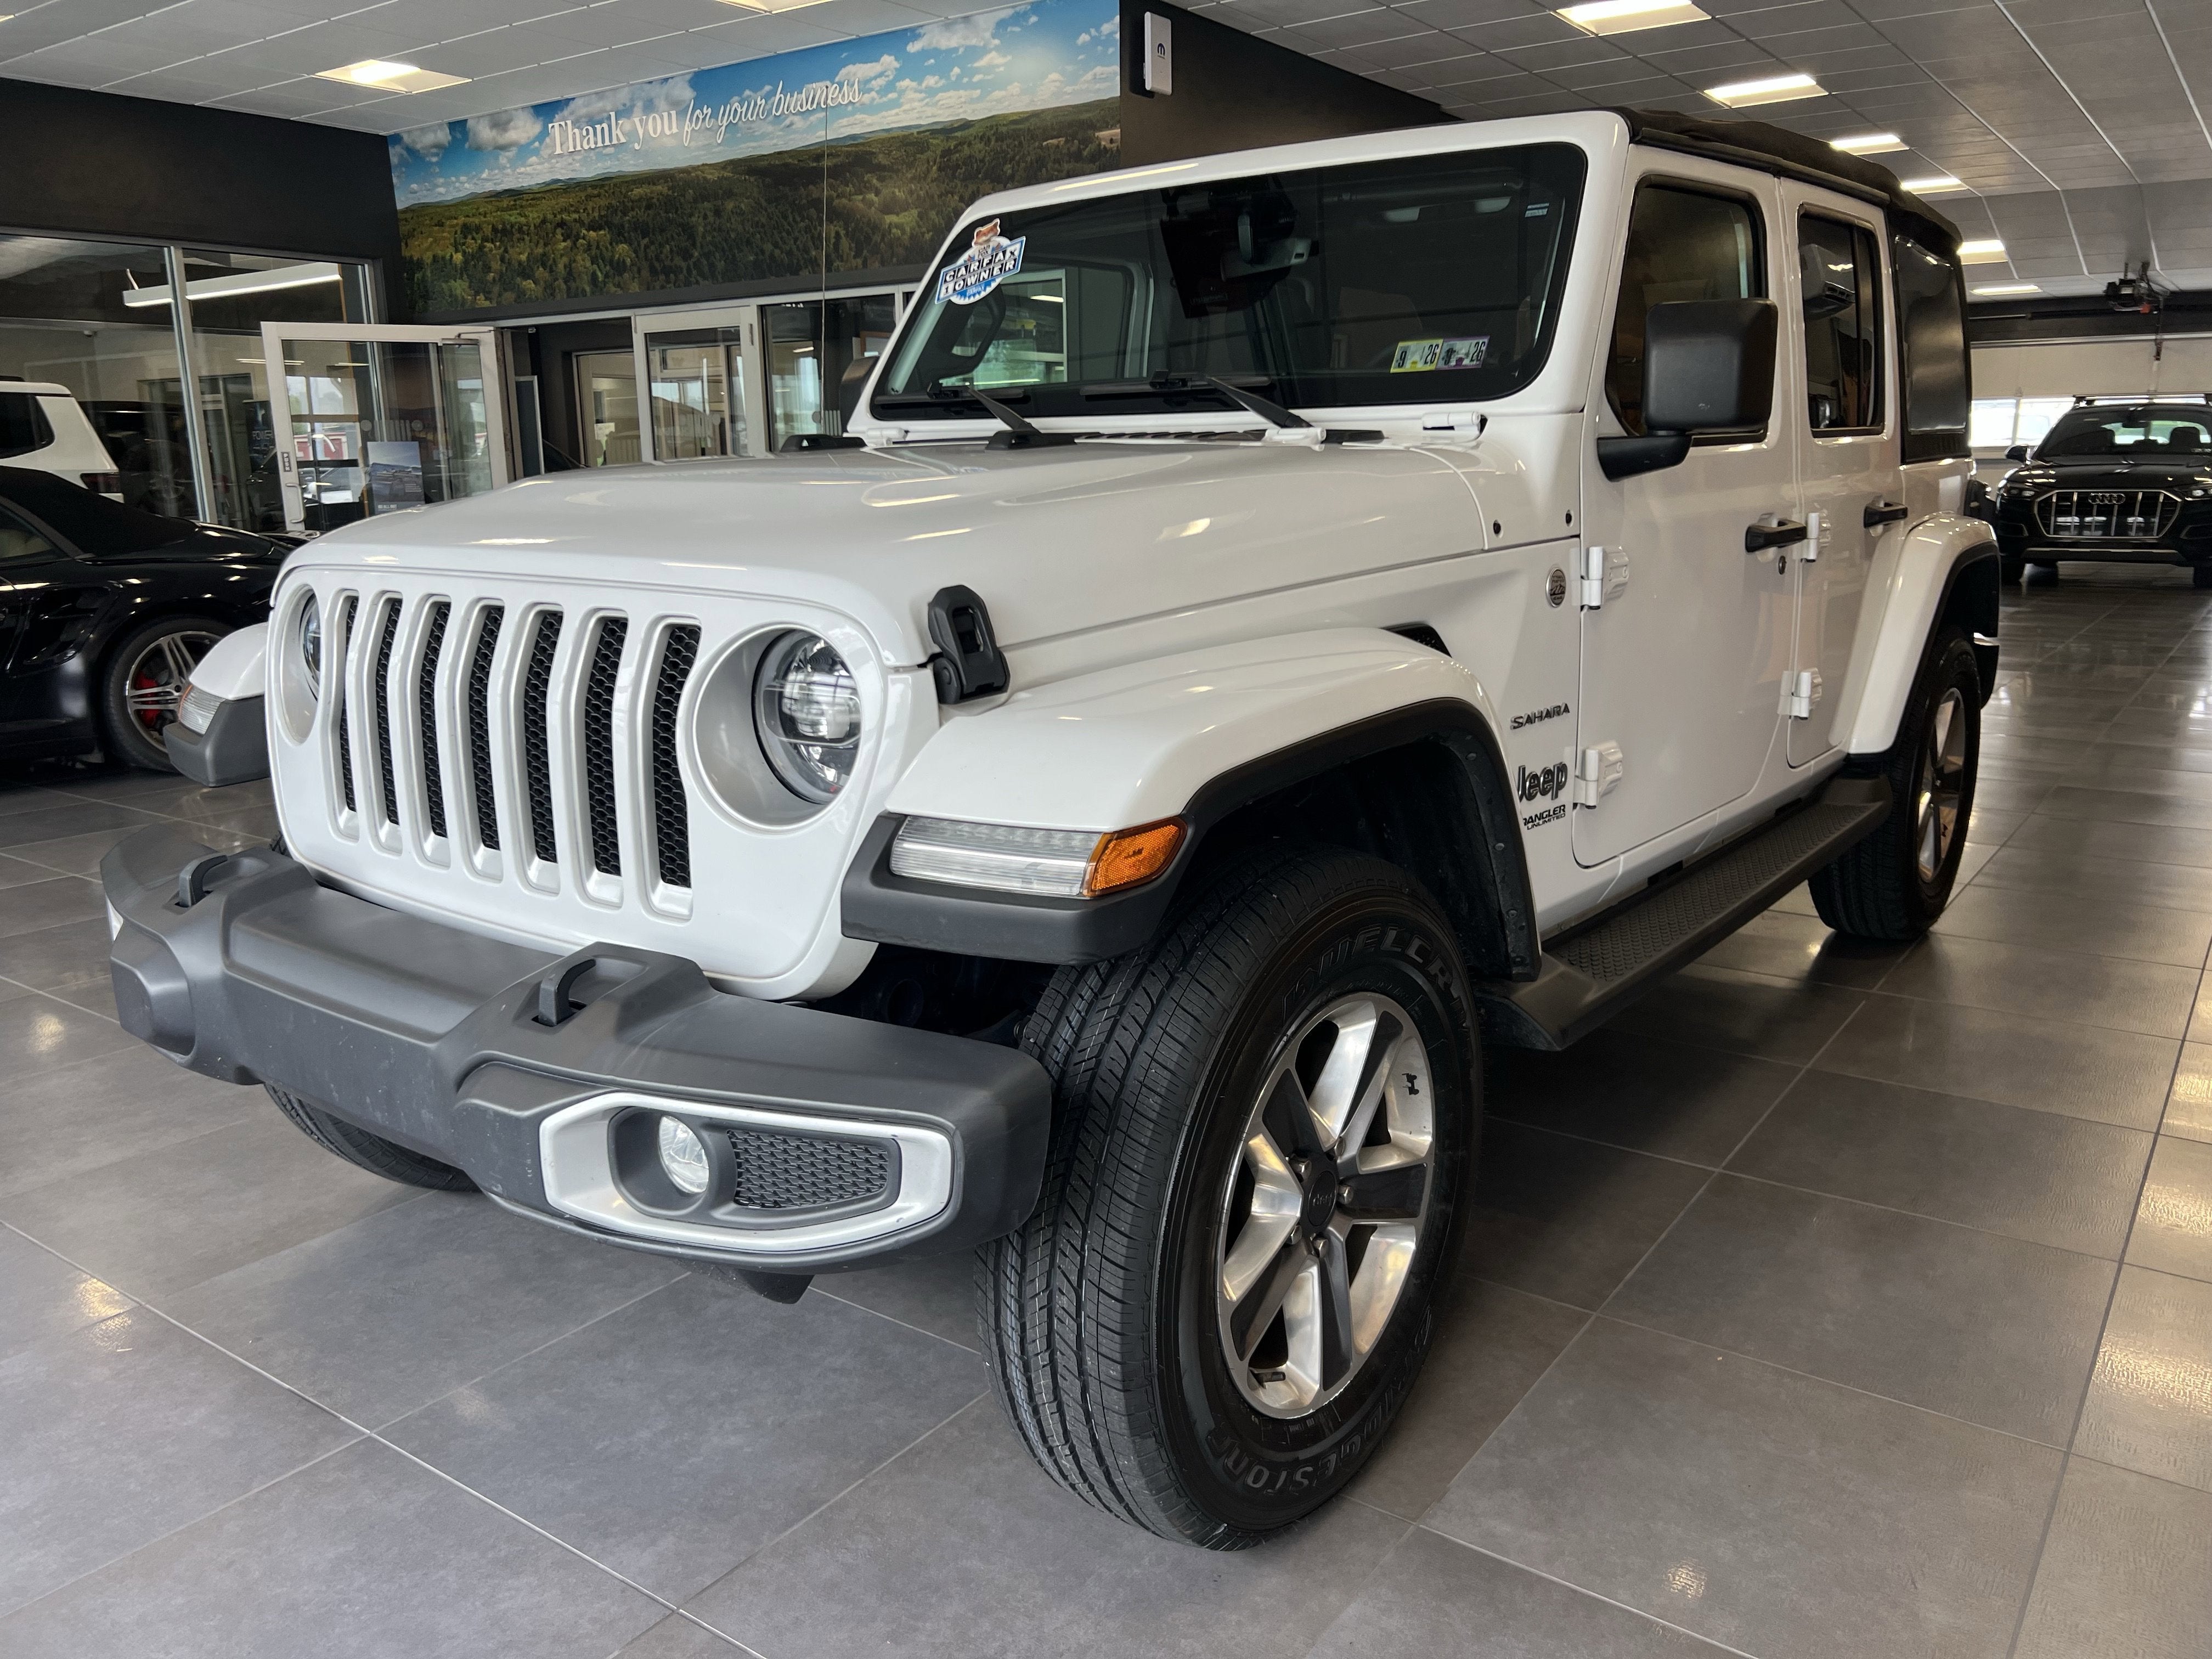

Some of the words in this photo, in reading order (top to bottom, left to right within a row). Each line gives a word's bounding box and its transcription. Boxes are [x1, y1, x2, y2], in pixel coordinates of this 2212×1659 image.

[549, 111, 627, 154] Thank
[633, 110, 679, 150] you
[684, 98, 713, 146] for
[716, 95, 767, 143] your
[772, 80, 862, 116] business
[945, 249, 1018, 283] CARFAX
[1424, 344, 1440, 365] 26
[1470, 341, 1486, 363] 26
[1510, 703, 1570, 730] SAHARA
[1517, 761, 1568, 803] Jeep
[1523, 804, 1566, 826] RANGLER
[1527, 812, 1566, 831] UNLIMITED
